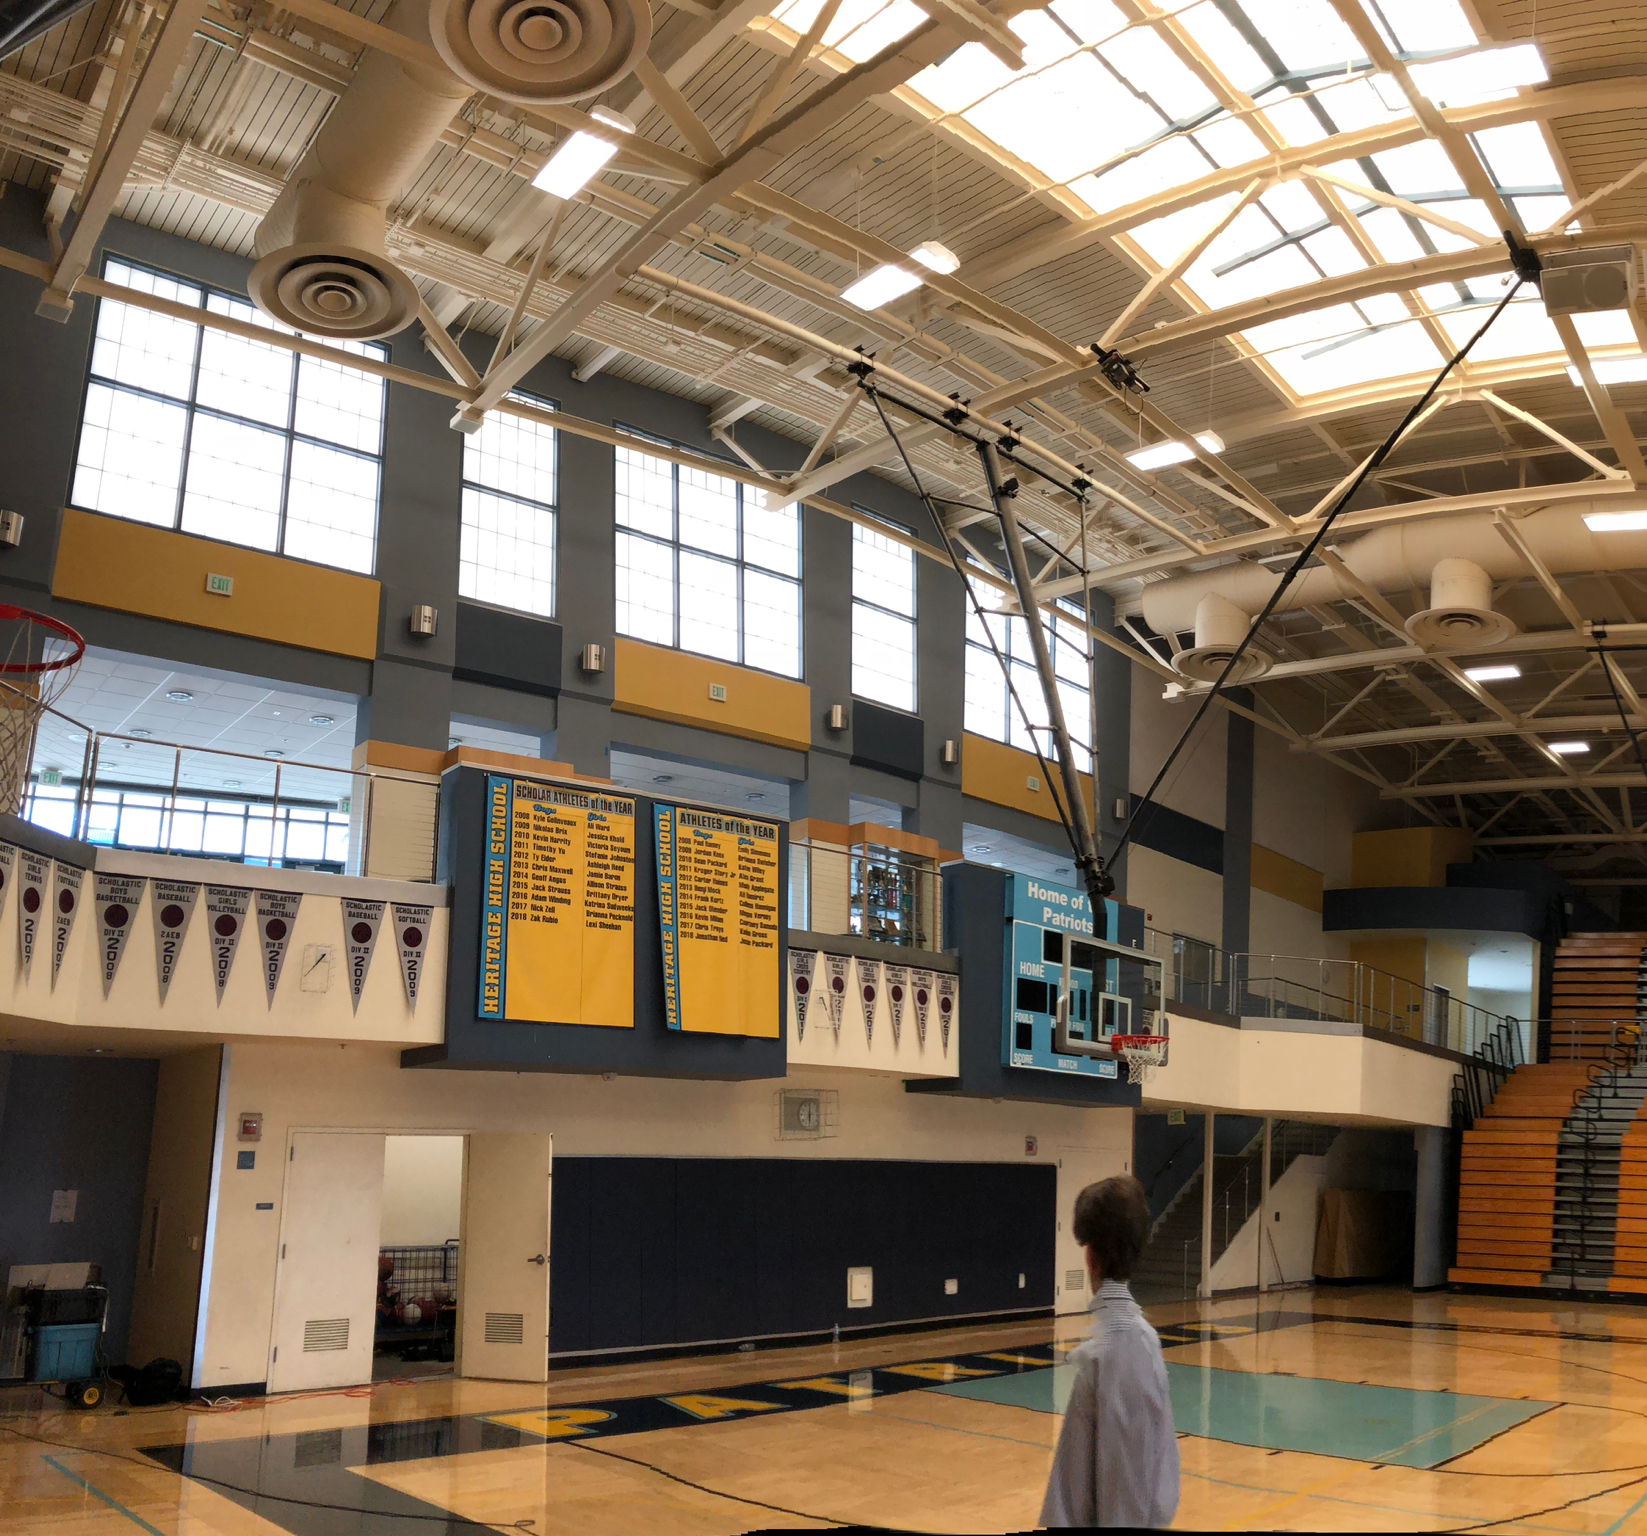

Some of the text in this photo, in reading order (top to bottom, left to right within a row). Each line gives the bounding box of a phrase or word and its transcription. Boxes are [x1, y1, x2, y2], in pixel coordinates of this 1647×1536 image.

[516, 784, 633, 814] SCHOLAR ATHLETES of the YEAR
[680, 812, 774, 839] ATHLETES of the YEAR
[515, 831, 548, 842] 2010 Kevin
[587, 832, 608, 841] Jessica
[514, 841, 528, 849] 2011
[533, 843, 556, 854] Timothy
[587, 842, 608, 851] Victoria
[21, 852, 50, 868] SCHOLASTIC
[514, 851, 528, 859] 2012
[533, 853, 539, 862] Ty
[28, 864, 41, 874] GIRLS
[57, 864, 82, 879] SCHOLASTIC
[513, 861, 528, 869] 2013
[532, 863, 547, 871] Chris
[25, 874, 42, 884] TENNIS
[58, 875, 79, 888] FOOTBALL
[513, 871, 547, 882] 2014 Geoff
[98, 877, 141, 888] SCHOLASTIC
[155, 883, 196, 893] SCHOLASTIC
[513, 881, 528, 889] 2015
[531, 883, 545, 891] Jack
[110, 887, 127, 895] BOYS
[208, 889, 248, 898] SCHOLASTIC
[1028, 881, 1068, 906] Home
[1071, 897, 1084, 910] of
[96, 894, 140, 905] BASKETBALL
[158, 893, 191, 903] BASEBALL
[218, 897, 237, 905] GIRLS
[260, 893, 297, 903] SCHOLASTIC
[483, 783, 507, 1014] HERITAGE HIGH SCHOOL
[512, 892, 547, 902] 2016 Adam
[207, 904, 246, 915] VOLLEYBALL
[270, 902, 286, 910] BOYS
[346, 902, 382, 911] SCHOLASTIC
[395, 907, 429, 915] SCHOLASTIC
[512, 902, 543, 912] 2017 Nick
[258, 909, 296, 918] BASKETBALL
[348, 911, 378, 920] BASEBALL
[511, 912, 527, 921] 2018
[658, 810, 677, 1024] HERITAGE HIGH SCHOOL
[398, 916, 426, 924] SOFTBALL
[1042, 907, 1093, 934] Patriots
[25, 919, 35, 963] 2007
[56, 928, 67, 972] 2007
[106, 938, 120, 979] 2008
[163, 941, 175, 983] 2008
[219, 947, 230, 987] 2008
[269, 950, 280, 989] 2009
[1020, 961, 1045, 978] HOME
[354, 956, 365, 994] 2009
[407, 960, 418, 997] 2009
[1014, 1011, 1034, 1024] FOULS
[1013, 1052, 1033, 1065] SCORE
[1058, 1058, 1078, 1070] MATCH
[474, 1321, 1256, 1438] PATRIS
